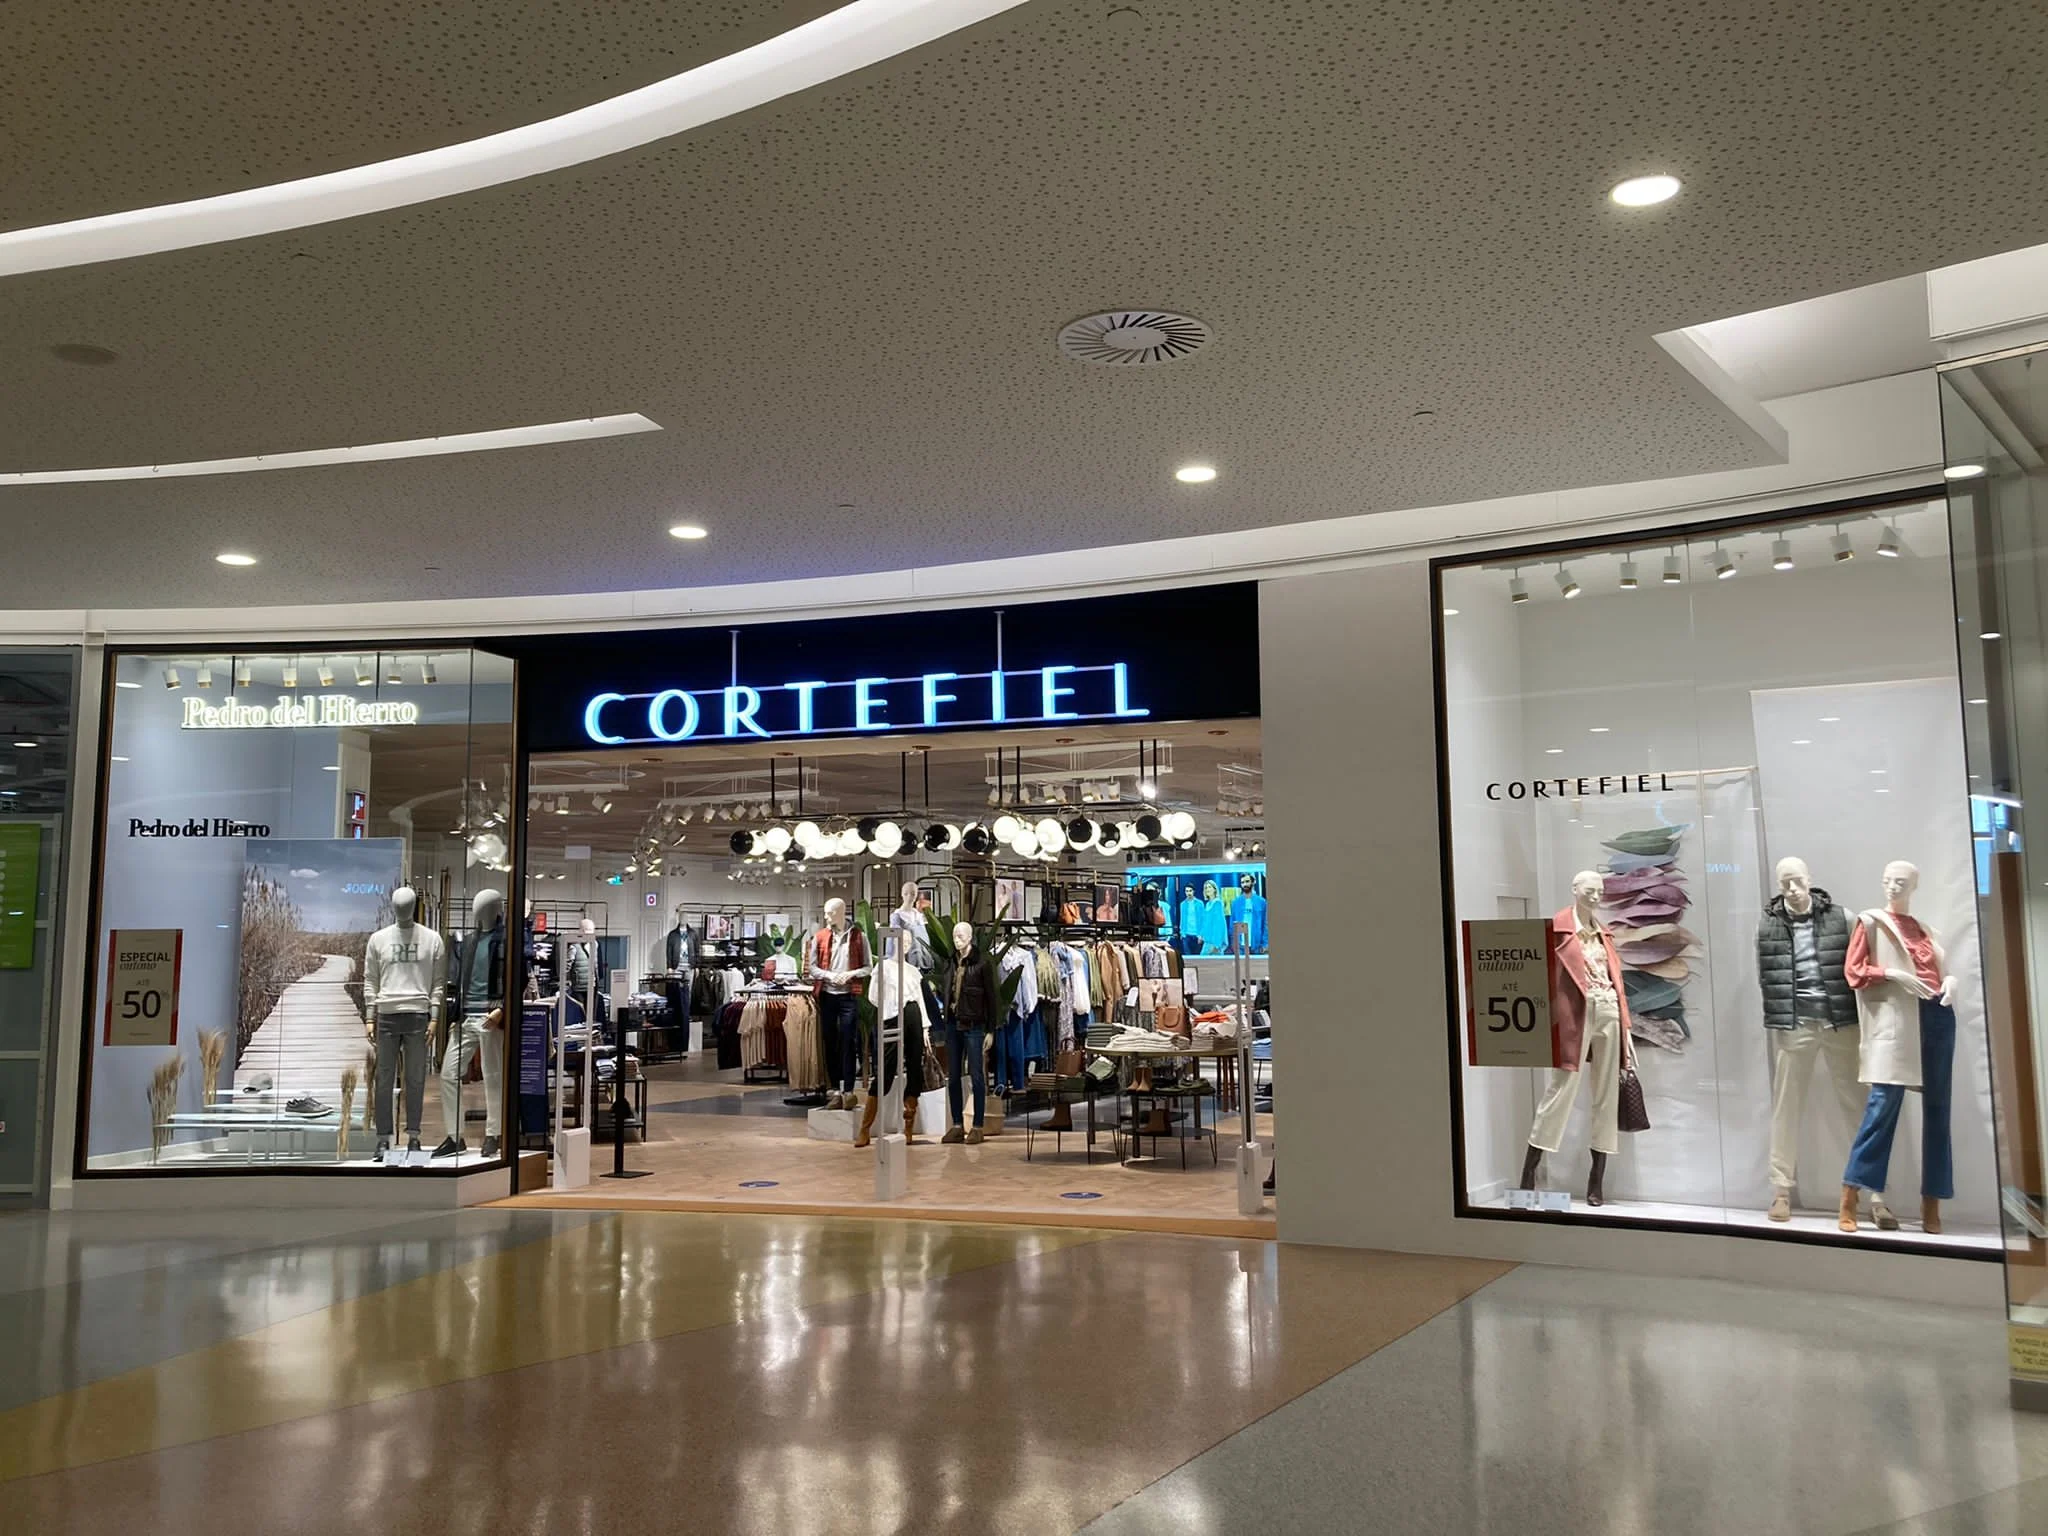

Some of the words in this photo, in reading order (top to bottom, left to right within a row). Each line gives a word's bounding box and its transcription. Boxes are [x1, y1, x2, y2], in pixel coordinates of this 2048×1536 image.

[585, 662, 1149, 744] CORTEFIEL
[182, 696, 267, 729] Pedro
[270, 696, 315, 727] del
[319, 694, 418, 726] Hierro
[1486, 773, 1674, 801] CORTEFIEL
[128, 818, 181, 838] Pedro
[182, 818, 209, 838] del
[213, 818, 270, 838] Hierro
[120, 951, 171, 962] ESPECIAL
[1477, 948, 1542, 961] ESPECIAL
[1478, 960, 1524, 972] outono
[1502, 981, 1519, 992] ATÉ
